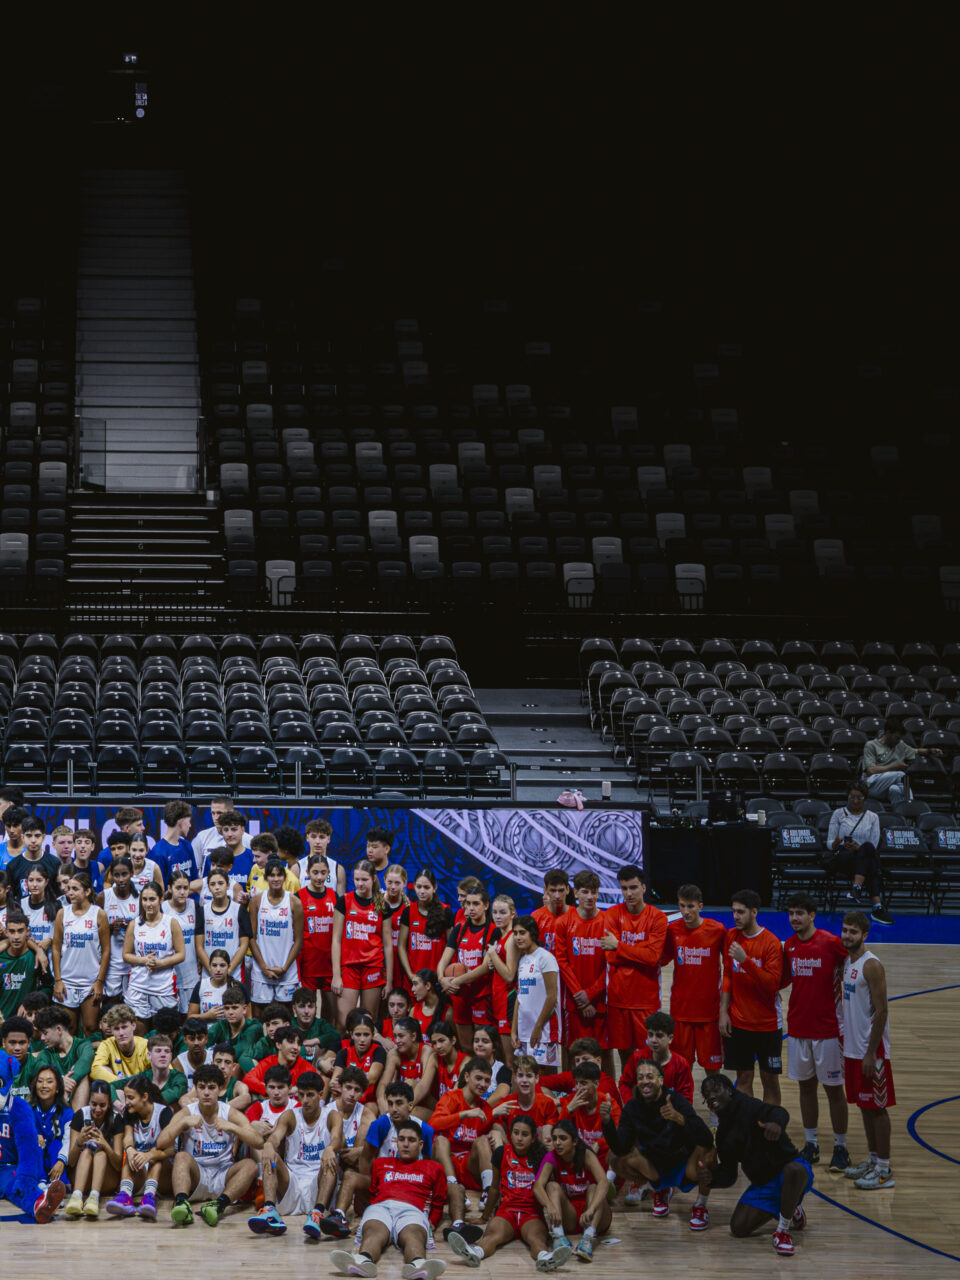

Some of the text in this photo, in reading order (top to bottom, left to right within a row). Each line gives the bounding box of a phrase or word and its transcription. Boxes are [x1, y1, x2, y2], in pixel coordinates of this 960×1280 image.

[129, 903, 136, 913] 10
[279, 907, 289, 916] 30
[85, 919, 93, 929] 19
[187, 915, 195, 924] 13
[225, 917, 233, 927] 14
[265, 920, 289, 929] Basketball
[70, 932, 94, 941] Basketball
[160, 930, 166, 939] 4
[211, 931, 234, 940] Basketball
[266, 928, 281, 936] School
[70, 940, 86, 948] School
[144, 942, 167, 951] Basketball
[211, 939, 226, 947] School
[353, 1121, 358, 1131] 3
[202, 1140, 227, 1150] Basketball
[303, 1141, 325, 1152] Basketball
[303, 1151, 321, 1160] School
[394, 1172, 424, 1183] Basketball
